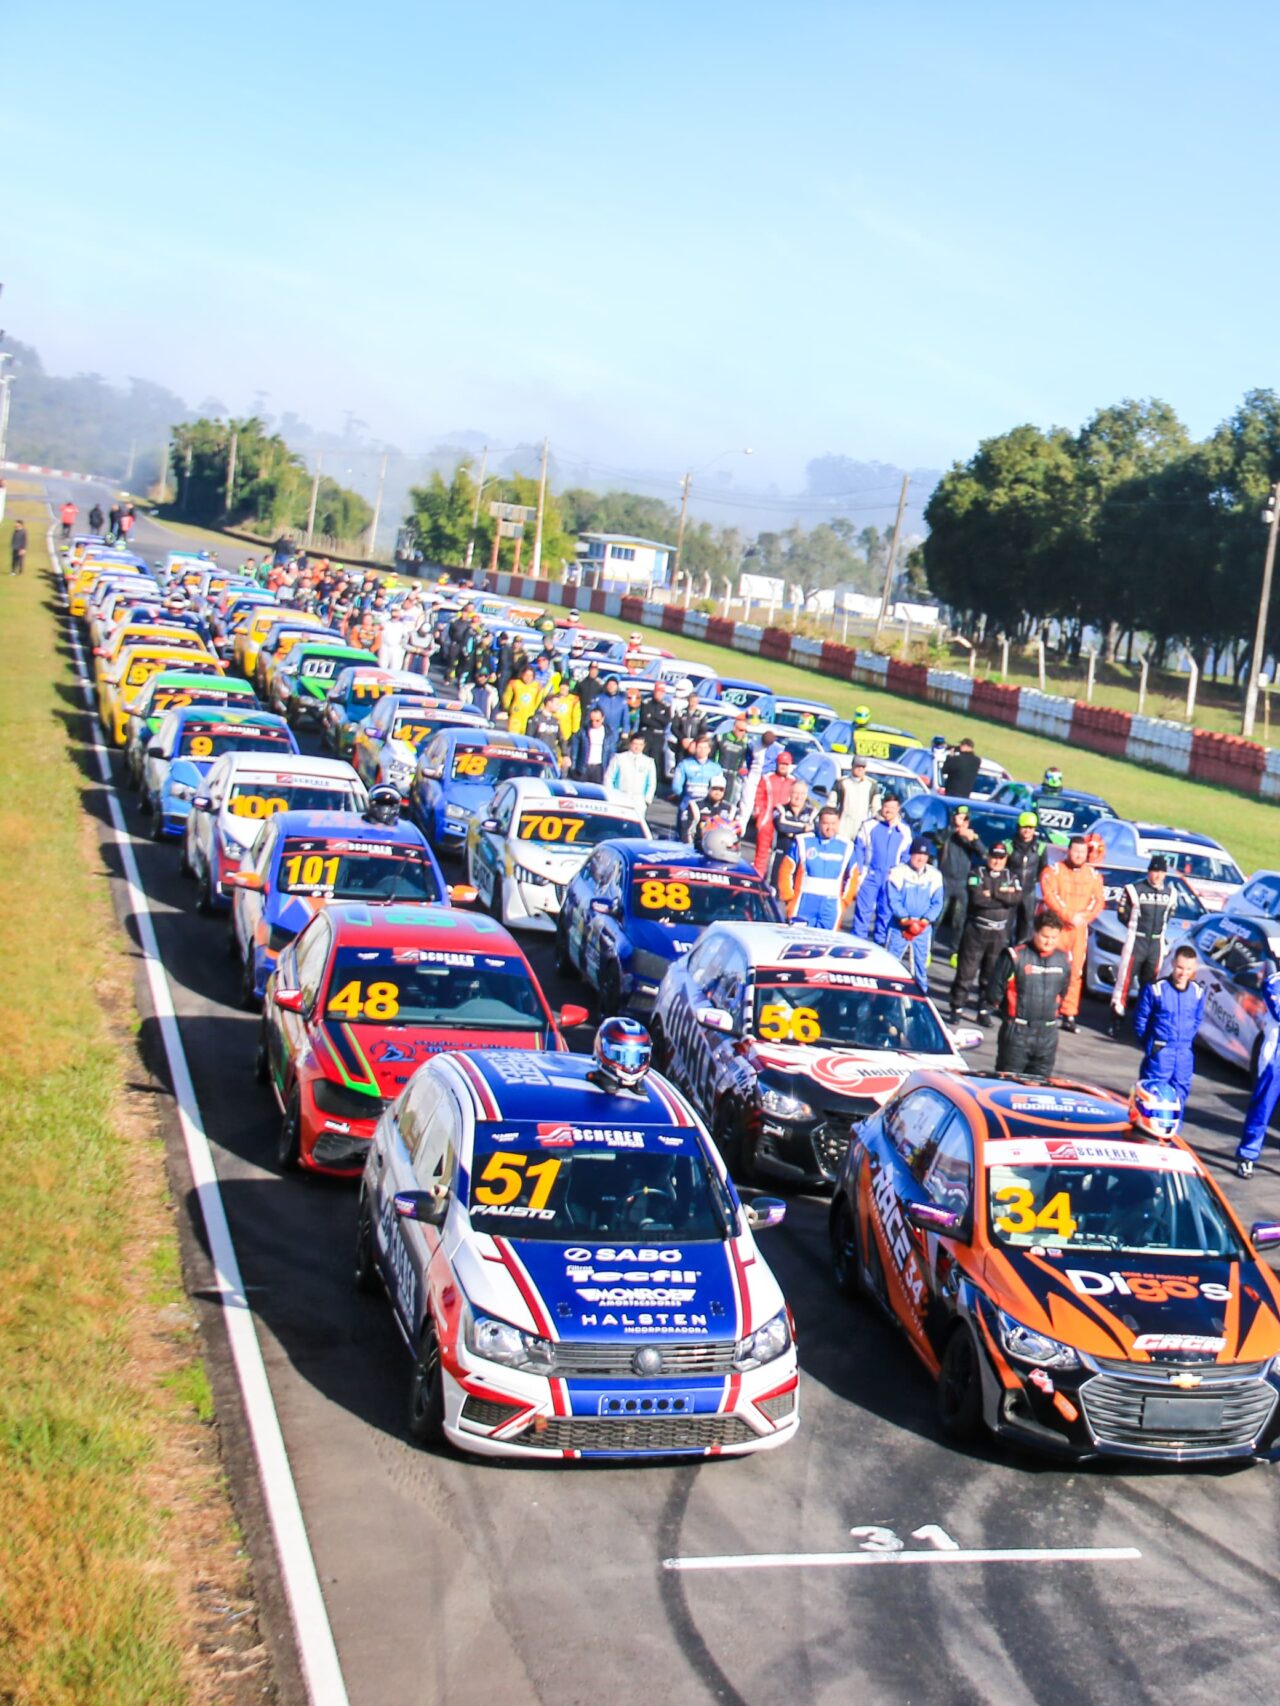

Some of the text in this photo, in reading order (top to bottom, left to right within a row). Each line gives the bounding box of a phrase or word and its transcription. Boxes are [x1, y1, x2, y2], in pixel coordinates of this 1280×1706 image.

[393, 725, 431, 744] 47
[456, 754, 488, 775] 18
[229, 795, 288, 819] 100
[520, 815, 585, 843] 707
[286, 855, 340, 885] 101
[640, 880, 691, 911] 88
[327, 980, 399, 1020] 48
[759, 1005, 821, 1043] 56
[573, 1127, 644, 1143] SCHERER
[1077, 1146, 1138, 1159] SCHERER
[474, 1151, 562, 1211] 51
[469, 1204, 556, 1220] FAUSTO
[873, 1162, 911, 1271] RACE
[995, 1186, 1077, 1239] 34
[581, 1313, 707, 1326] HALSTEN
